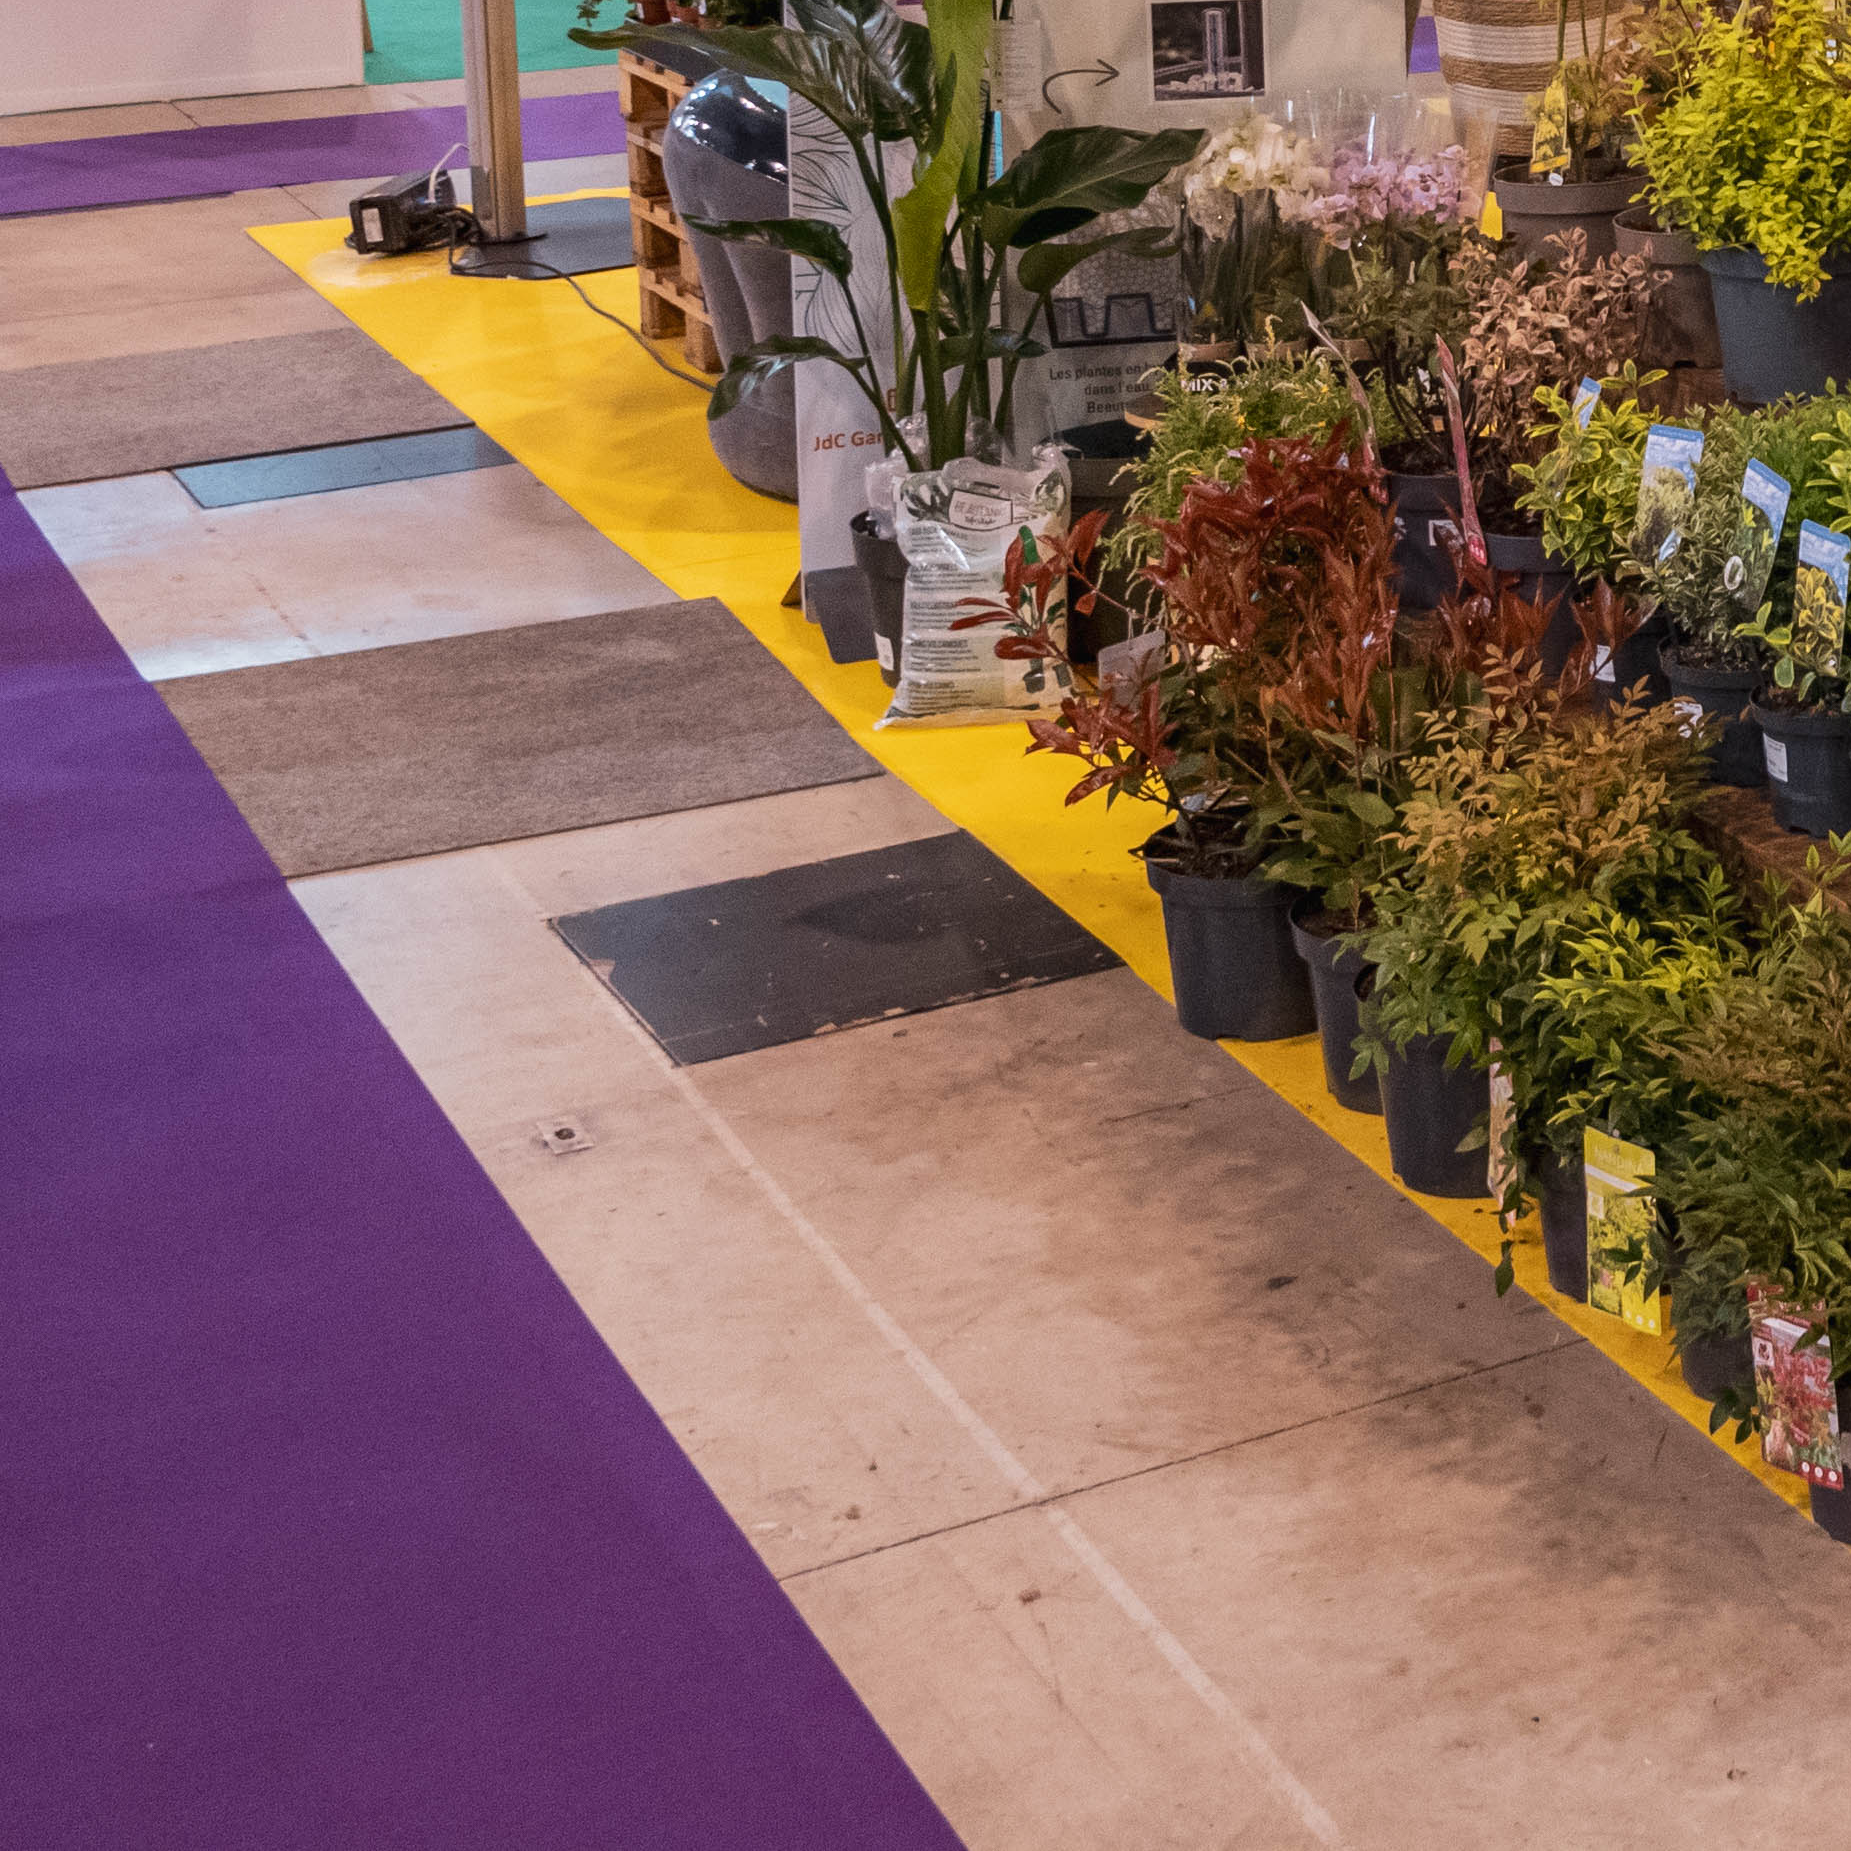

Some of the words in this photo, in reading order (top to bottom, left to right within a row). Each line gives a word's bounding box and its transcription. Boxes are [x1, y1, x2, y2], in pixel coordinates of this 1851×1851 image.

[1049, 367, 1072, 381] Les
[1075, 364, 1123, 381] plantes
[1126, 367, 1142, 377] en
[1084, 383, 1114, 397] dans
[1087, 400, 1128, 414] Beaut
[814, 433, 847, 452] JdC
[850, 431, 887, 450] Gar
